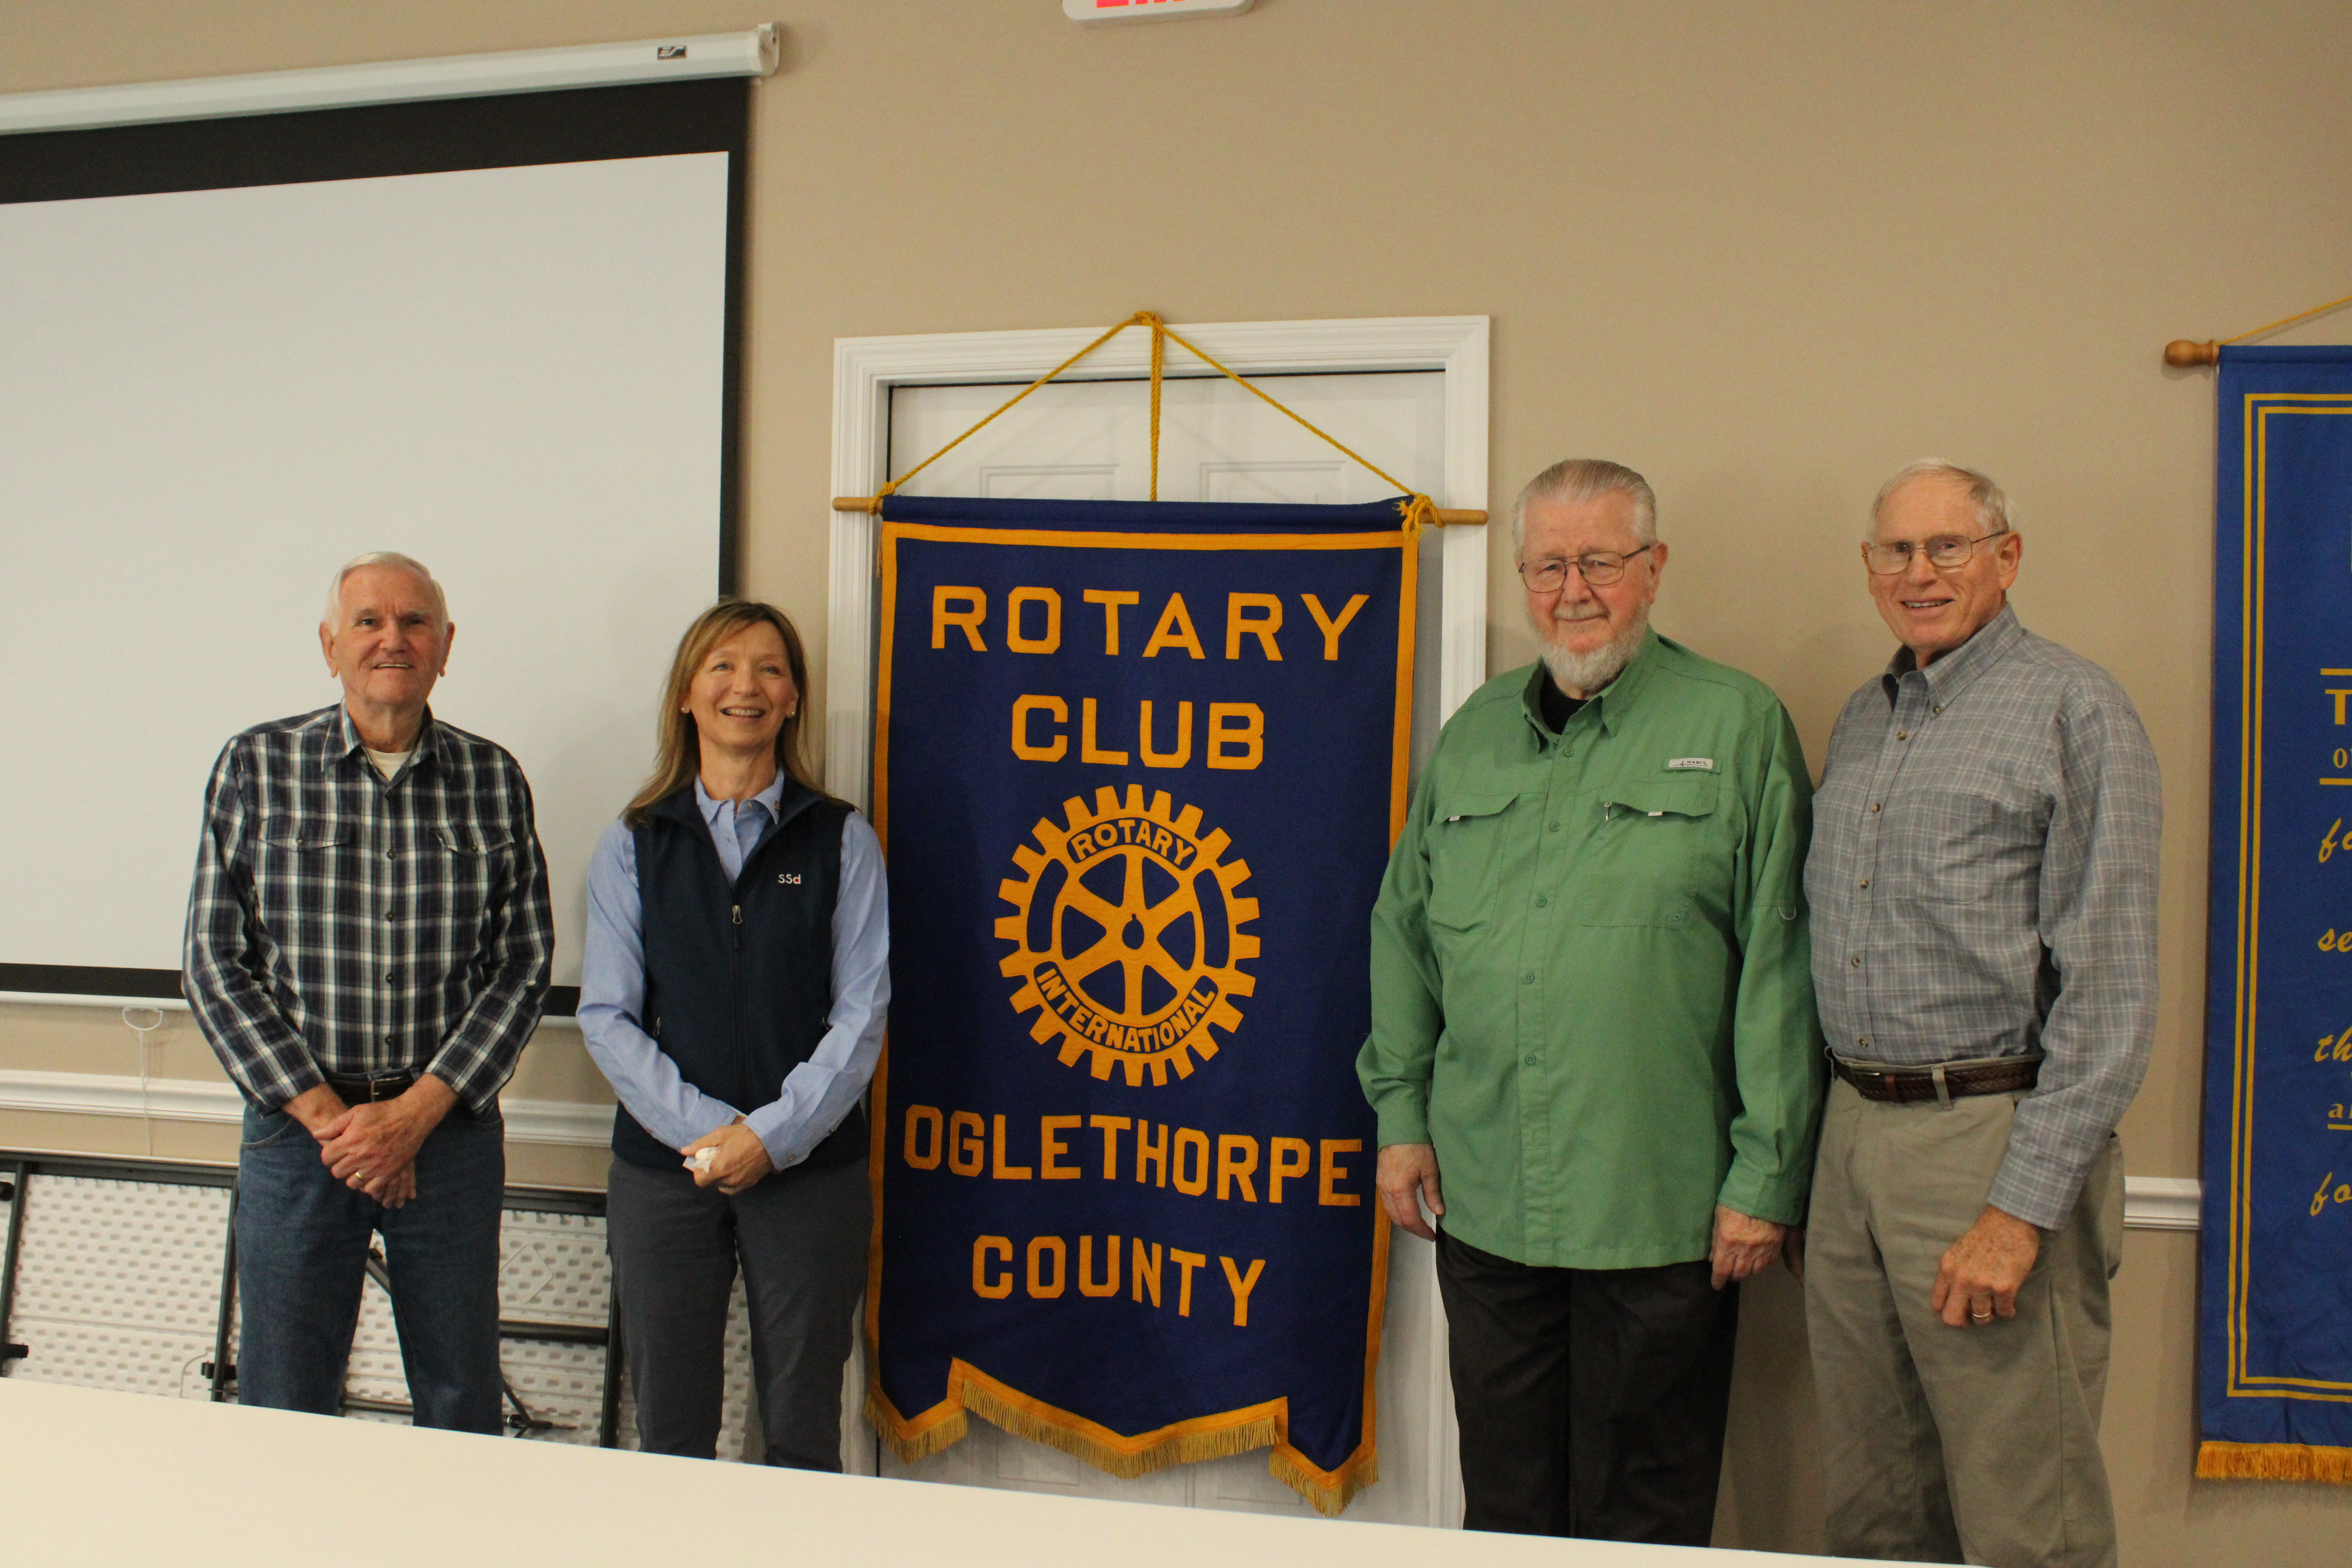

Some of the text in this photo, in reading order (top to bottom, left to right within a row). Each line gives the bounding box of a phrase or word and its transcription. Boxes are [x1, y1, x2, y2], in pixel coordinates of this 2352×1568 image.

[931, 585, 1370, 661] ROTARY
[1011, 693, 1265, 770] CLUB
[1071, 819, 1194, 866] ROTARY
[1036, 968, 1215, 1053] INTERNATIONAL
[903, 1105, 1363, 1207] OGLETHORPE
[972, 1234, 1266, 1327] COUNTY
